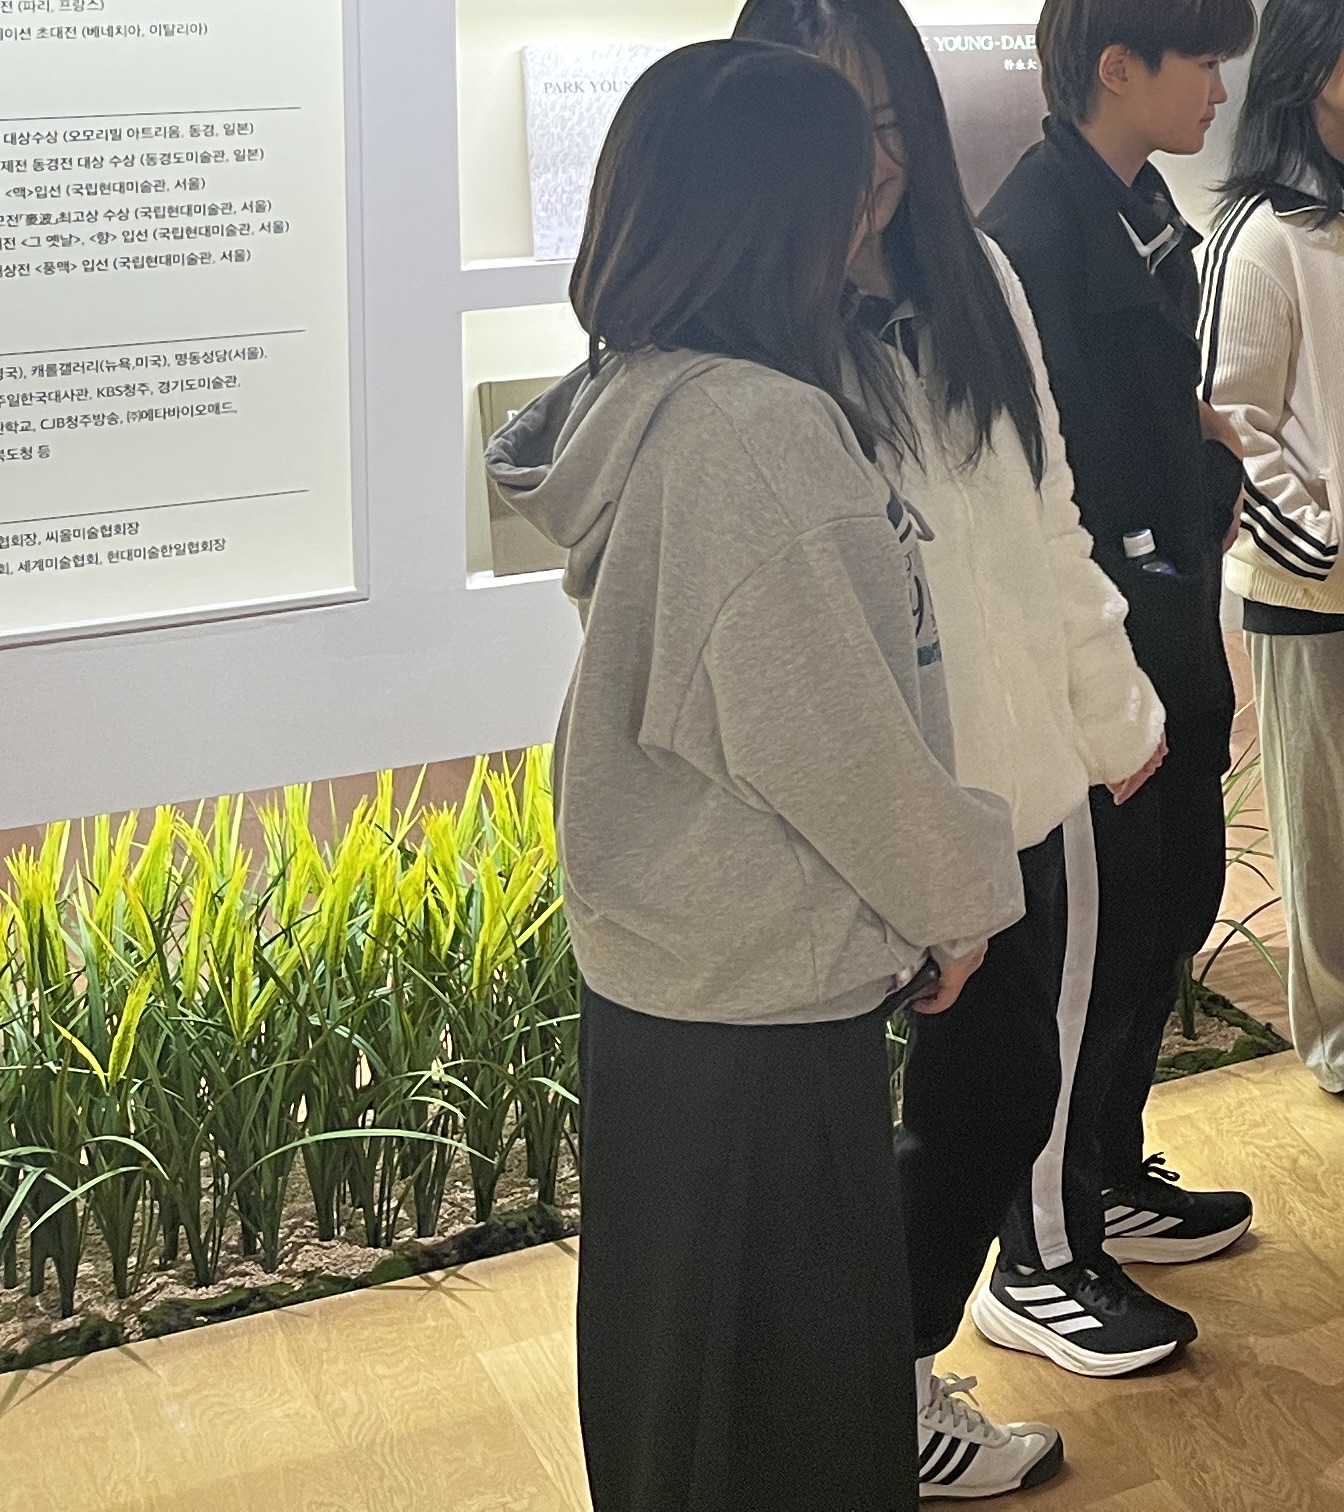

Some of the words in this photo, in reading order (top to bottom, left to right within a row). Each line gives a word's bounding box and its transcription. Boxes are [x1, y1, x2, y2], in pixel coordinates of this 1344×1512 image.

[17, 0, 55, 14] (파리,
[0, 26, 32, 41] 이션
[36, 26, 77, 40] 초대전
[81, 24, 145, 40] (베네치아,
[149, 22, 208, 37] 이탈리아)
[934, 34, 1037, 52] YOUNG-DAE
[544, 81, 585, 94] PARK
[3, 129, 58, 146] 대상수상
[222, 121, 255, 137] 일본)
[33, 157, 73, 172] 동경전
[78, 155, 105, 169] 대상
[109, 154, 135, 168] 수상
[233, 148, 264, 163] 일본)
[66, 178, 170, 197] (국립현대미술관,
[174, 176, 206, 191] 서울)
[103, 207, 130, 222] 수상
[134, 202, 237, 220] (국립현대미술관,
[241, 199, 272, 214] 서울)
[0, 236, 16, 251] 전
[121, 228, 148, 243] 입선
[152, 223, 255, 241] (국립현대미술관,
[258, 220, 290, 235] 서울)
[82, 257, 109, 273] 입선
[113, 252, 216, 270] (국립현대미술관,
[220, 248, 252, 263] 서울)
[37, 444, 50, 459] 등
